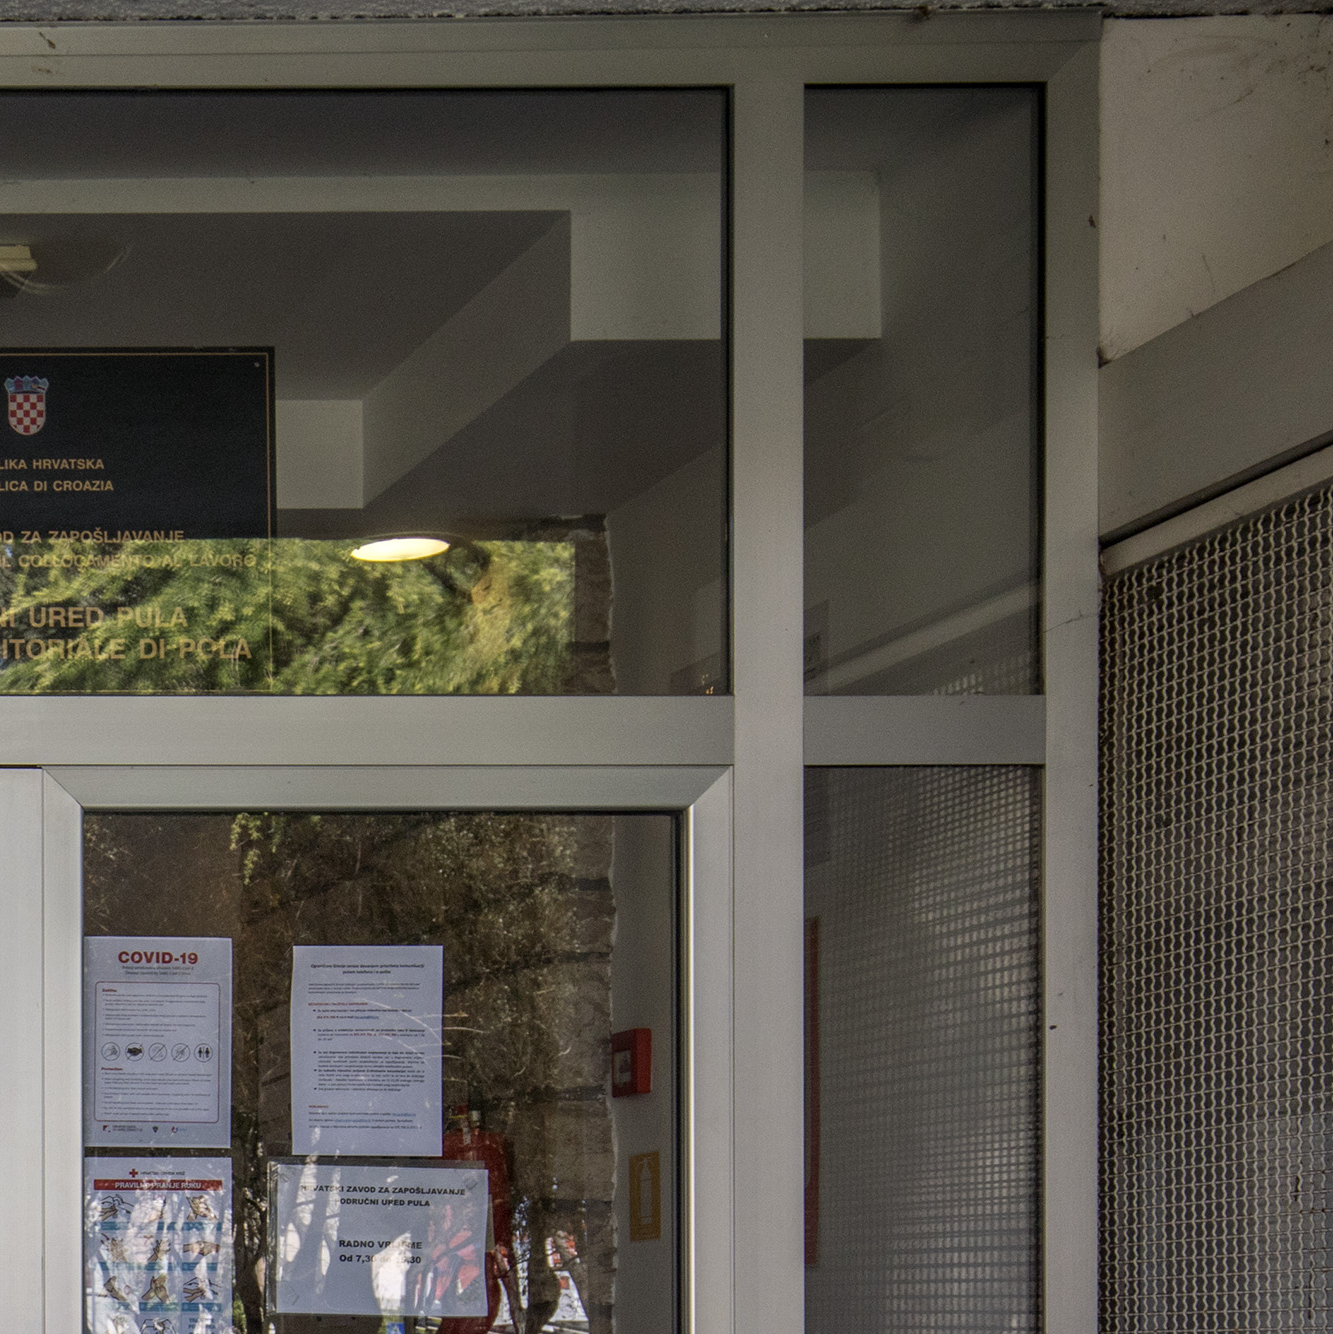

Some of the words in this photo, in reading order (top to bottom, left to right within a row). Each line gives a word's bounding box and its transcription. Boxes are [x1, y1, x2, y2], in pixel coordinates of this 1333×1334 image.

[33, 458, 105, 470] HRVATSKA
[34, 480, 48, 492] DI
[53, 480, 114, 492] CROAZIA
[21, 531, 42, 543] ZA
[49, 527, 184, 543] ZAPOŠLJAVANJE
[190, 554, 257, 568] LAVORO
[29, 607, 103, 627] URED
[117, 607, 188, 627] PULA
[139, 639, 165, 659] DI
[179, 639, 252, 659] POLA
[118, 951, 198, 965] COVID-19
[392, 1186, 466, 1196] ZAPOŠLJAVANJE
[339, 1240, 374, 1248] RADNO
[339, 1254, 353, 1263] Od
[355, 1254, 374, 1264] 7,30
